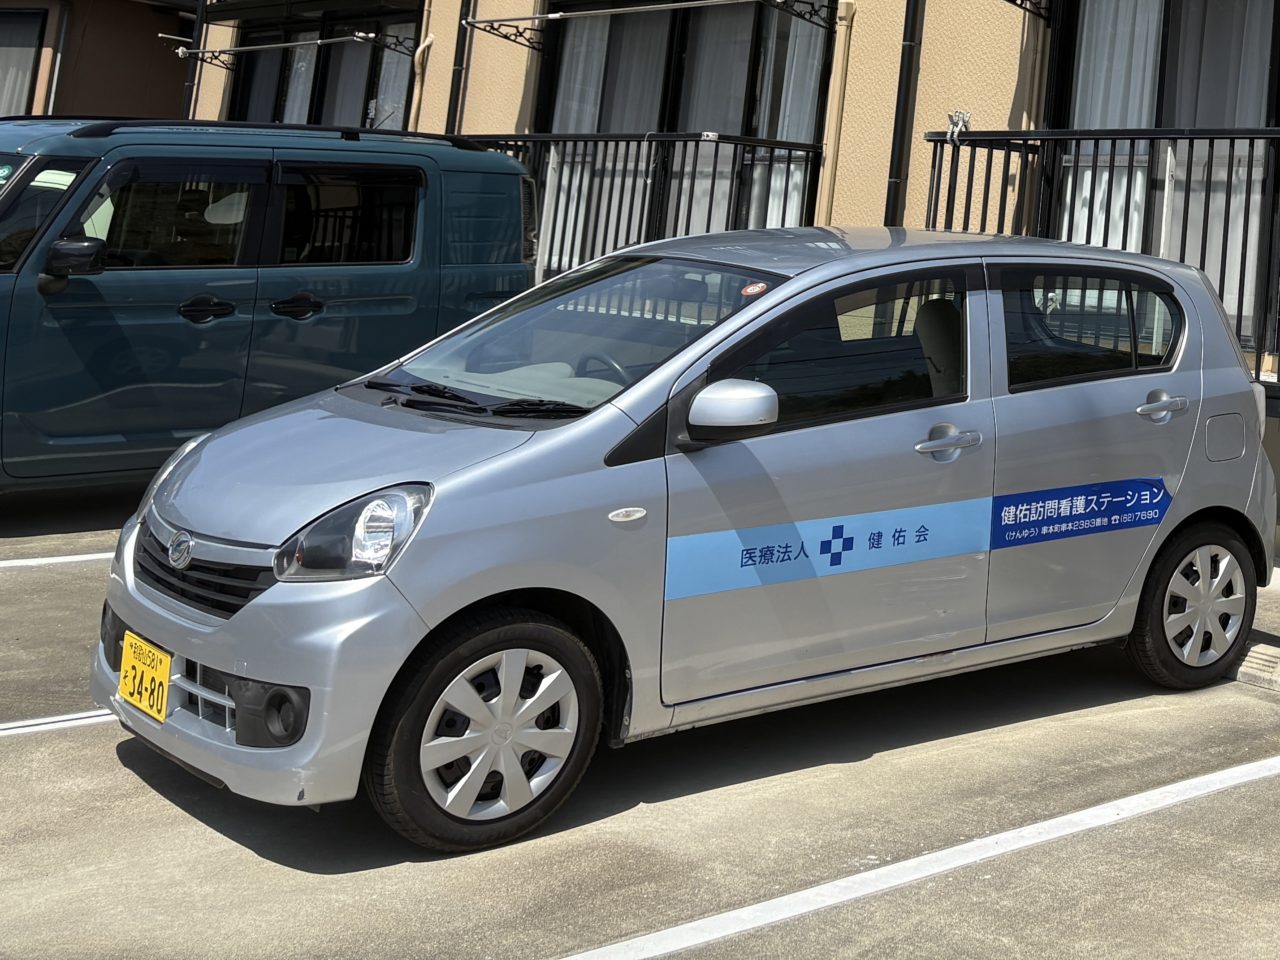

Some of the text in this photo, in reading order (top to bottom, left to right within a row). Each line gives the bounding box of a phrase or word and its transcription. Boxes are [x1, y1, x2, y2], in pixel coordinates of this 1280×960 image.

[1001, 487, 1165, 526] 健佑訪問看護ステーション
[740, 524, 930, 568] 医療法人 健佑会
[128, 664, 165, 715] 34-80
